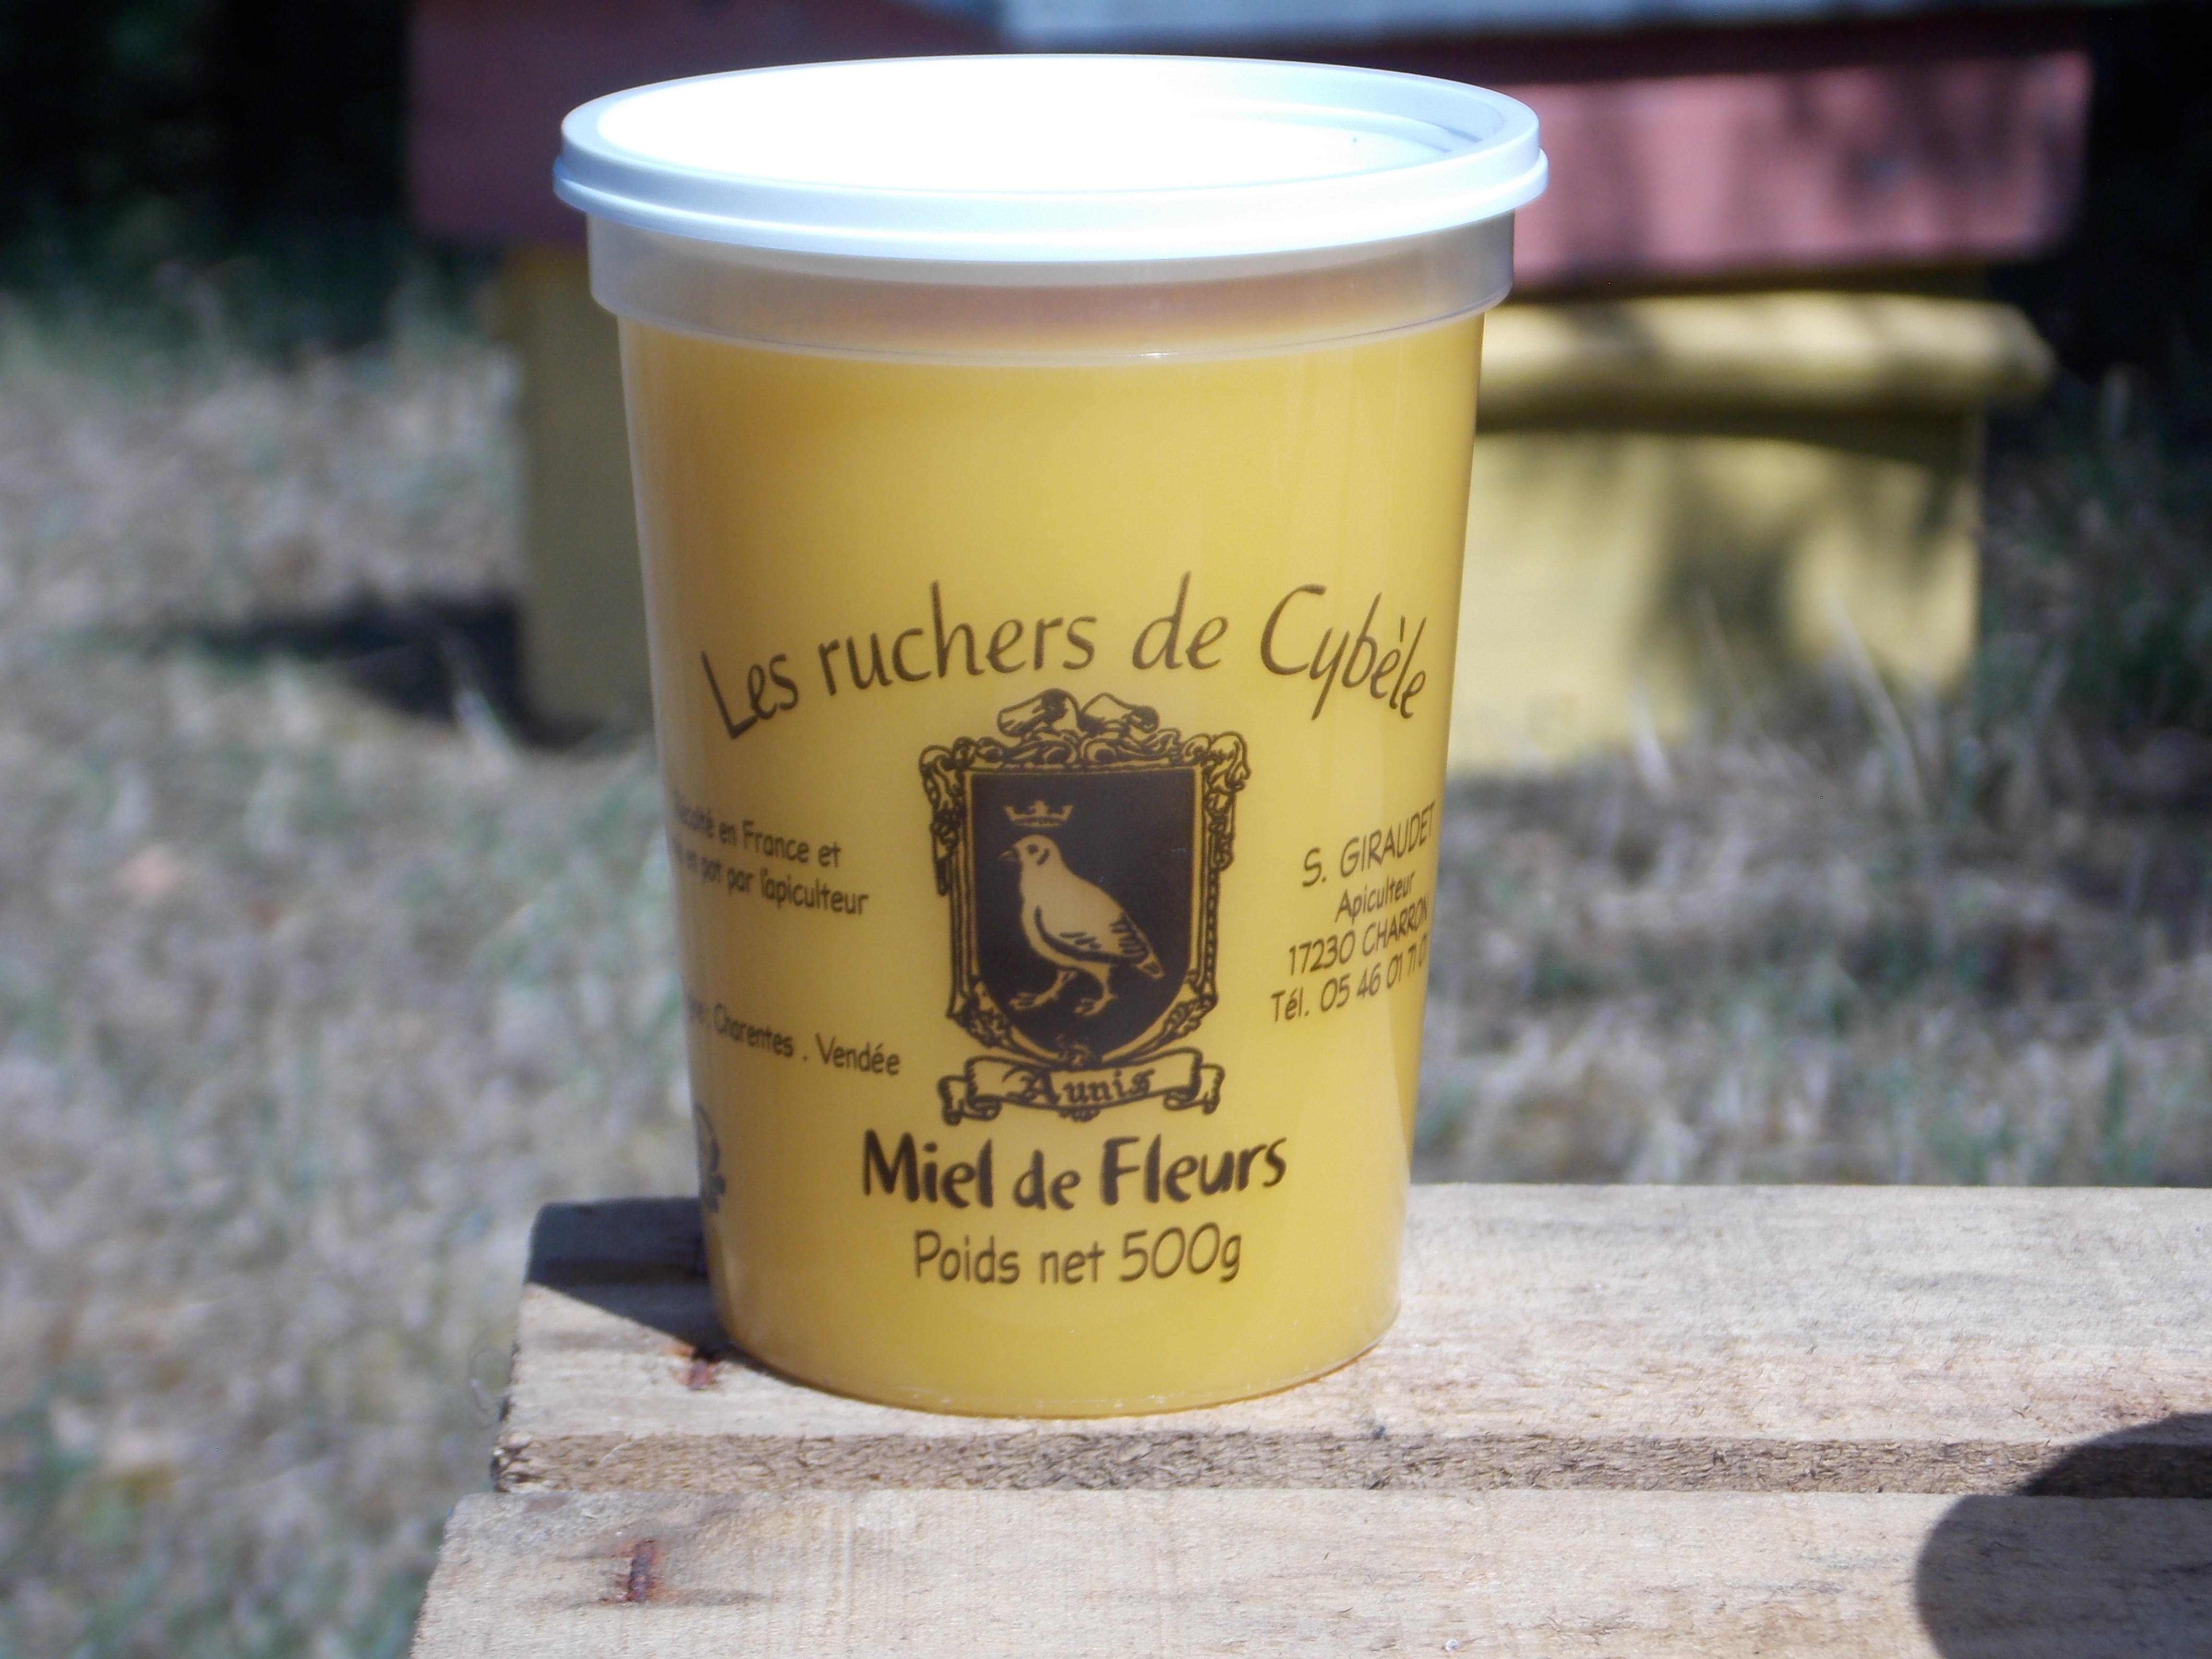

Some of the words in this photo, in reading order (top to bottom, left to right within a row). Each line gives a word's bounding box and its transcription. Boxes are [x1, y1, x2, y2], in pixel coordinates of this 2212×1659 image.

[701, 650, 798, 739] Les
[817, 580, 1097, 696] ruchers
[1132, 571, 1229, 670] de
[1260, 583, 1427, 721] Cybèle
[742, 820, 809, 864] France
[817, 841, 842, 868] et
[1302, 846, 1327, 887] S.
[1340, 800, 1435, 878] GIRAUDET
[727, 866, 754, 895] par
[1334, 870, 1415, 925] Apiculteur
[1289, 930, 1356, 976] 17230
[1271, 986, 1310, 1023] Tél.
[1320, 973, 1351, 1012] 05
[1357, 962, 1381, 998] 46
[713, 1002, 795, 1058] Charentes
[815, 1033, 901, 1075] Vendée
[1002, 1063, 1155, 1105] Aunis
[863, 1129, 994, 1208] Miel
[1012, 1149, 1081, 1210] de
[1101, 1133, 1287, 1206] Fleurs
[913, 1229, 1020, 1284] Poids
[1038, 1239, 1105, 1285] net
[1119, 1222, 1242, 1283] 500g
